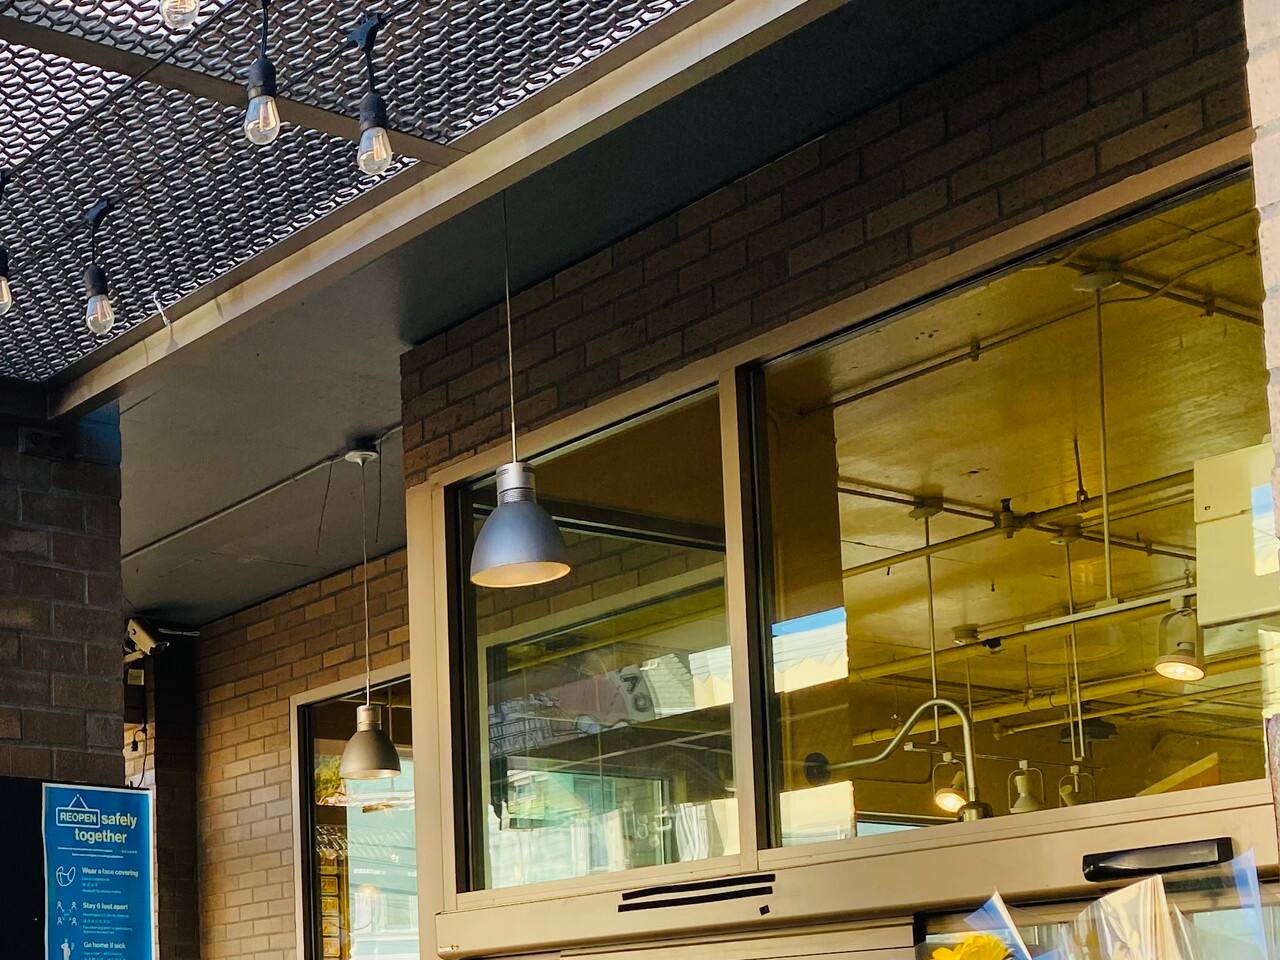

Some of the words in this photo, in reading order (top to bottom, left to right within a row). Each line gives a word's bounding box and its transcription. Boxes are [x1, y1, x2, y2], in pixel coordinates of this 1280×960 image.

[60, 812, 96, 823] REOPEN
[101, 812, 137, 829] safely
[74, 828, 128, 844] together
[82, 902, 96, 910] Stay
